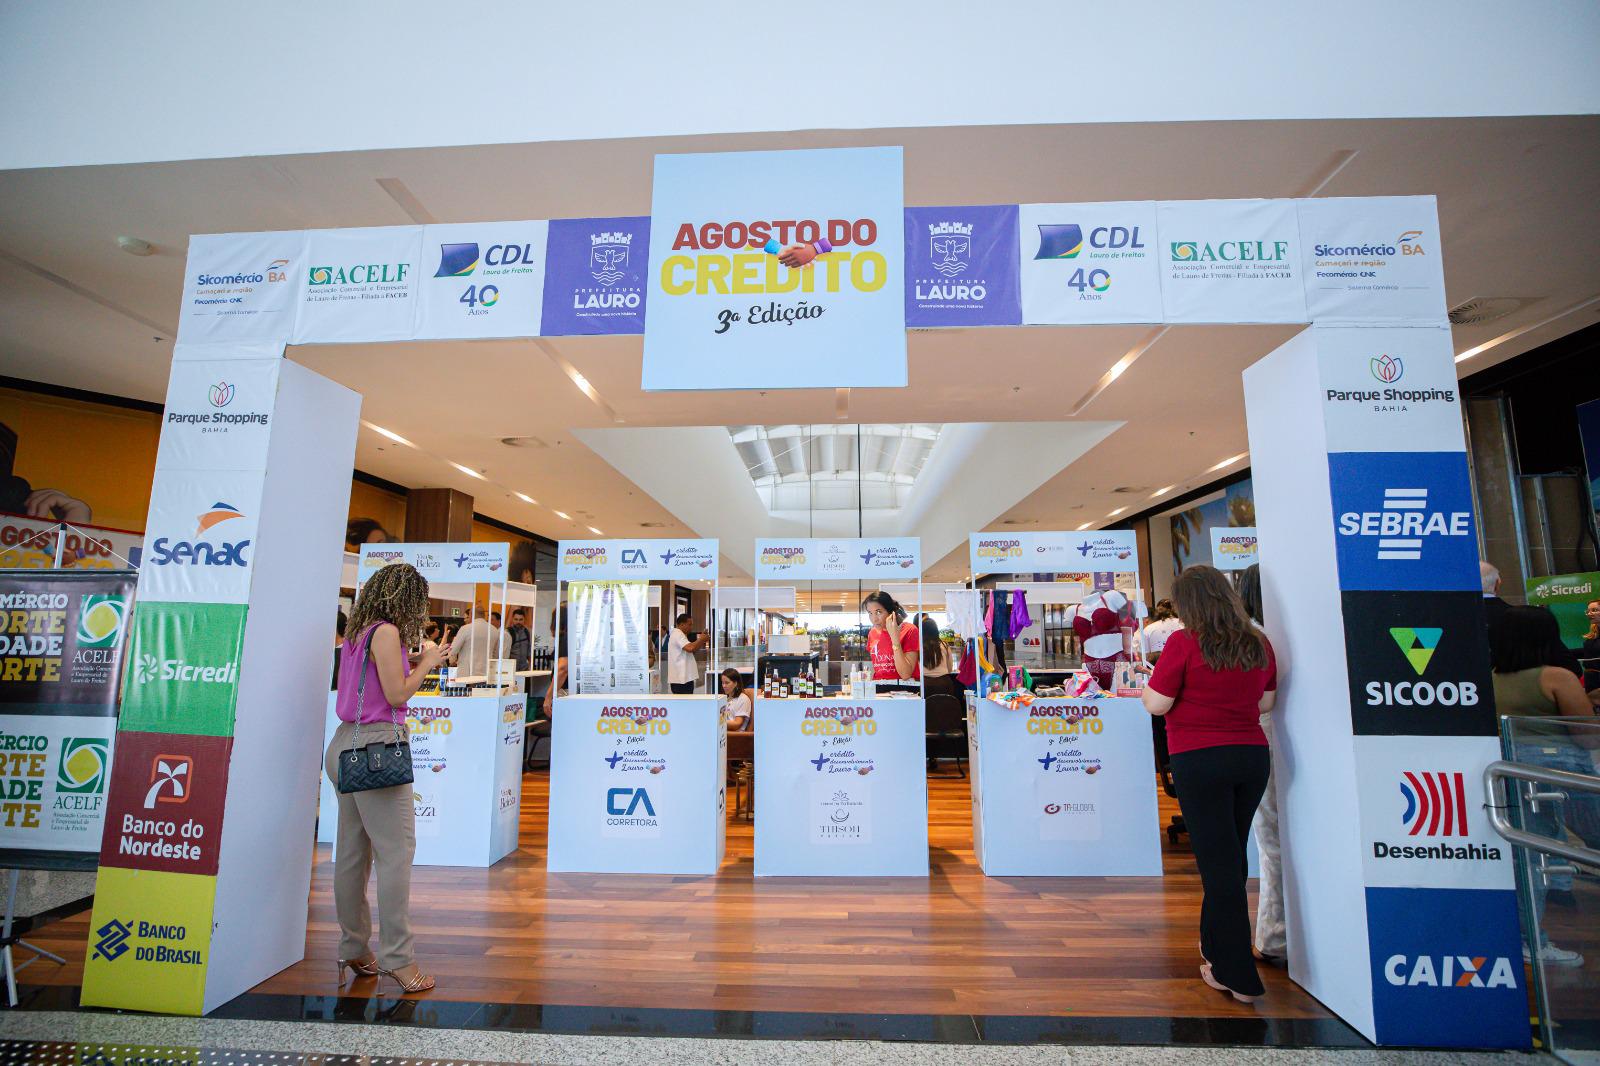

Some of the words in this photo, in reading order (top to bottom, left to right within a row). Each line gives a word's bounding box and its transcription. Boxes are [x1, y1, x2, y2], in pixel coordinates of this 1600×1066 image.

[671, 219, 820, 250] AGOSTO
[827, 218, 877, 247] DO
[1089, 226, 1145, 249] CDL
[484, 243, 534, 266] CDL
[1199, 241, 1289, 262] ACELF
[1314, 243, 1396, 257] Sicomércio
[1401, 244, 1425, 256] BA
[332, 263, 410, 284] ACELF
[660, 243, 888, 296] CRÉDITO
[1317, 270, 1357, 278] Fecomércio
[197, 272, 264, 286] Sicomércio
[268, 272, 287, 283] BA
[1067, 267, 1111, 292] 40
[459, 284, 499, 308] 40
[573, 293, 641, 309] LAURO
[915, 285, 987, 301] LAURO
[1079, 293, 1102, 301] Anos
[467, 308, 489, 316] Anos
[748, 301, 827, 326] Edição
[1327, 389, 1381, 403] Parque
[1383, 388, 1455, 403] Shopping
[168, 412, 210, 424] Parque
[211, 412, 269, 425] Shopping
[1338, 512, 1470, 536] SEBRAE
[84, 534, 113, 557] DO
[1221, 536, 1250, 544] AGOSTO
[595, 547, 606, 555] DO
[1551, 582, 1592, 597] Sicredi
[160, 658, 237, 684] Sicredi
[1365, 681, 1479, 706] SICOOB
[435, 707, 451, 718] DO
[600, 706, 650, 718] AGOSTO
[651, 706, 668, 718] DO
[804, 706, 855, 719] AGOSTO
[856, 706, 874, 718] DO
[1029, 705, 1080, 717] AGOSTO
[1081, 705, 1099, 717] DO
[623, 749, 648, 757] crédito
[829, 750, 855, 758] crédito
[1056, 749, 1082, 757] crédito
[621, 763, 644, 772] Lauro
[828, 764, 852, 774] Lauro
[1055, 764, 1079, 773] Lauro
[52, 795, 103, 811] ACELF
[606, 787, 657, 817] CA
[122, 813, 176, 837] Banco
[180, 818, 204, 839] do
[606, 818, 658, 827] CORRETORA
[119, 835, 202, 861] Nordeste
[1373, 841, 1502, 861] Desenbahia
[138, 920, 186, 941] BANCO
[135, 946, 155, 961] DO
[155, 945, 203, 965] BRASIL
[1384, 954, 1517, 989] CAIXA
